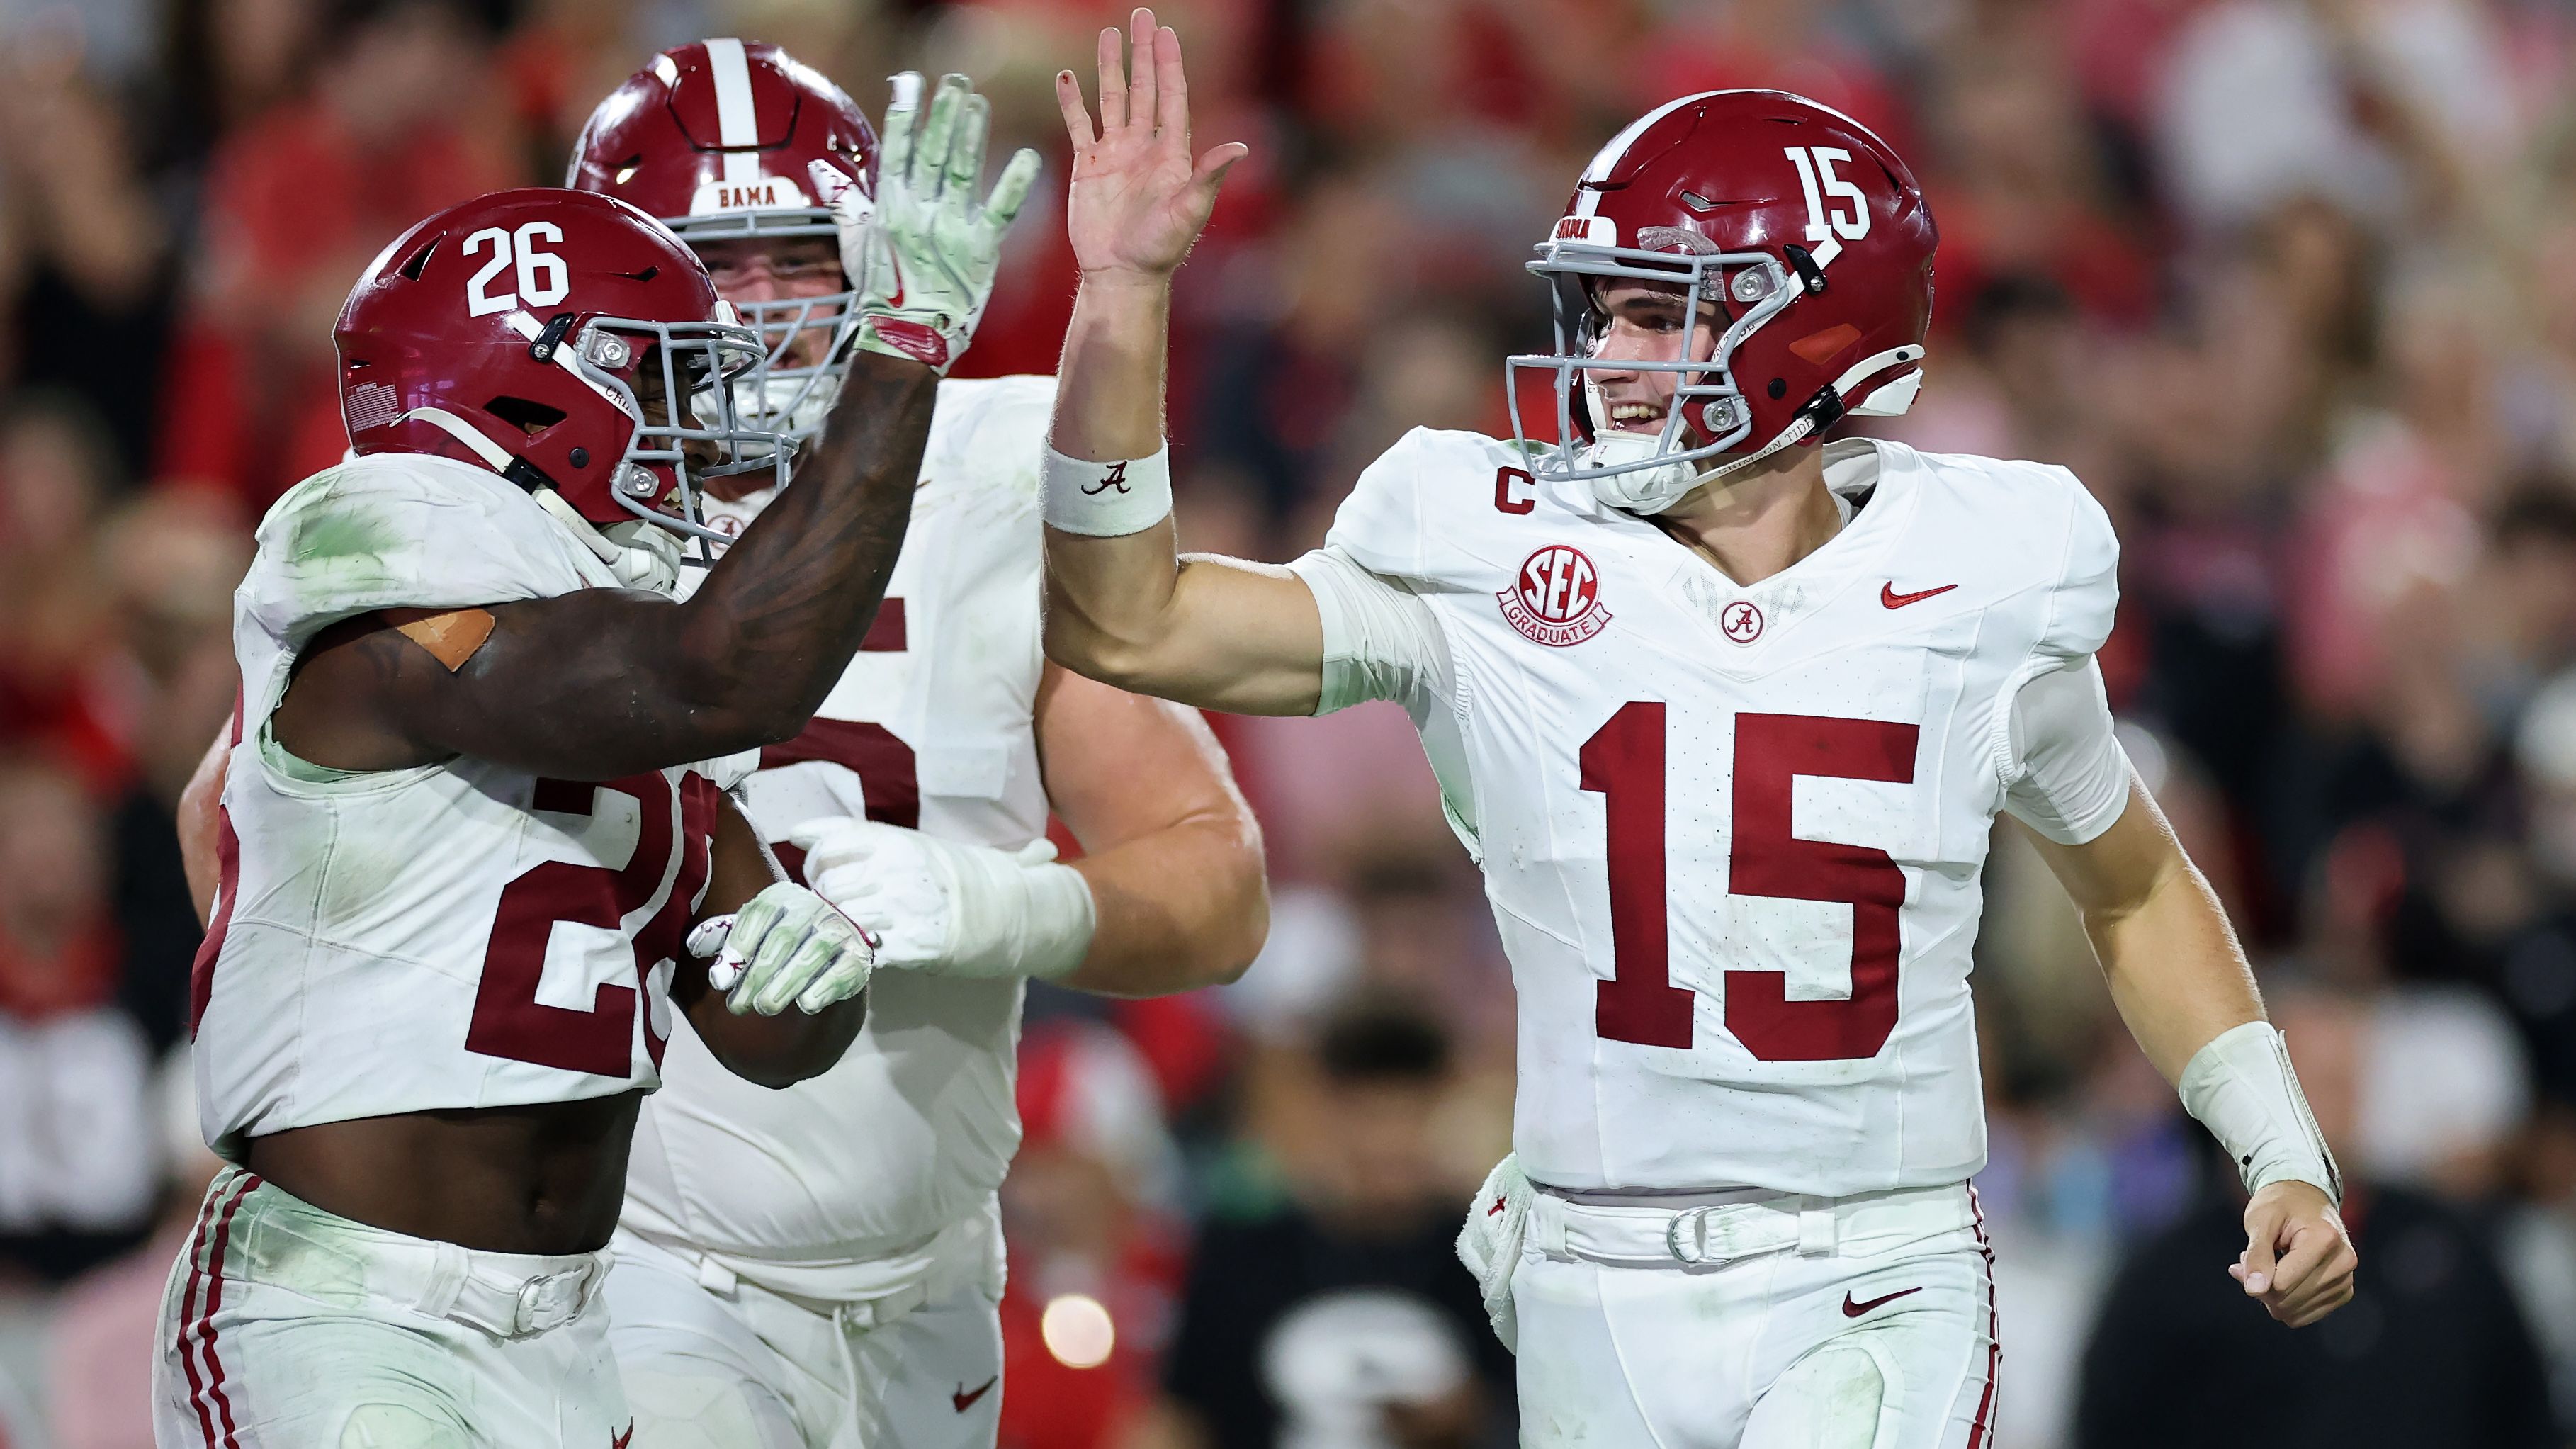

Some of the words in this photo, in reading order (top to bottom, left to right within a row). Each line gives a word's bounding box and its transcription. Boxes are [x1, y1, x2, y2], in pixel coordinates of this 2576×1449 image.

[718, 186, 776, 208] BAMA
[1784, 146, 1871, 242] 15
[463, 222, 569, 317] 26
[1718, 440, 1782, 475] CRIMSON
[1784, 417, 1814, 442] TIDE
[1081, 461, 1131, 495] A
[1495, 466, 1535, 515] C
[1524, 548, 1593, 620] SEC
[1508, 607, 1593, 643] GRADUATE
[1727, 608, 1753, 633] A
[1580, 701, 1920, 1061] 15
